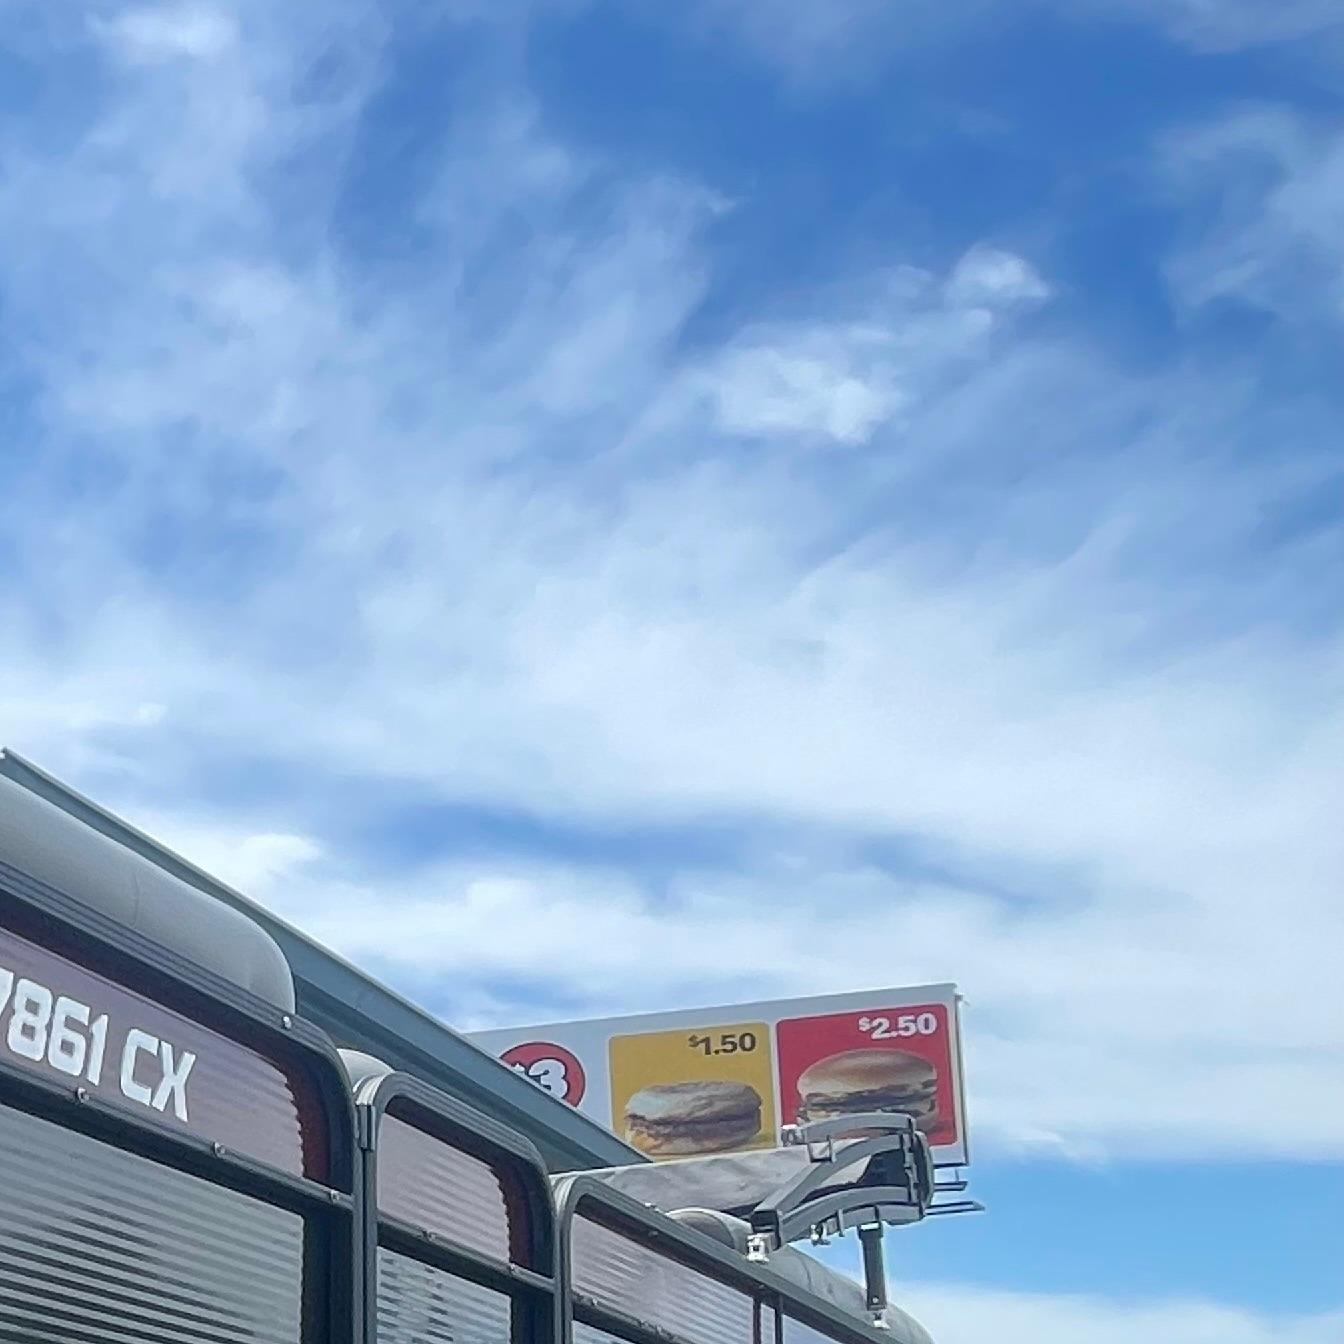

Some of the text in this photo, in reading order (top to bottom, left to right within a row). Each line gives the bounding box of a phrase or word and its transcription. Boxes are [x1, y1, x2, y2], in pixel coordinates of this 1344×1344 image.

[858, 1012, 937, 1040] $2.50
[688, 1032, 757, 1056] $1.50
[119, 1027, 196, 1123] CX
